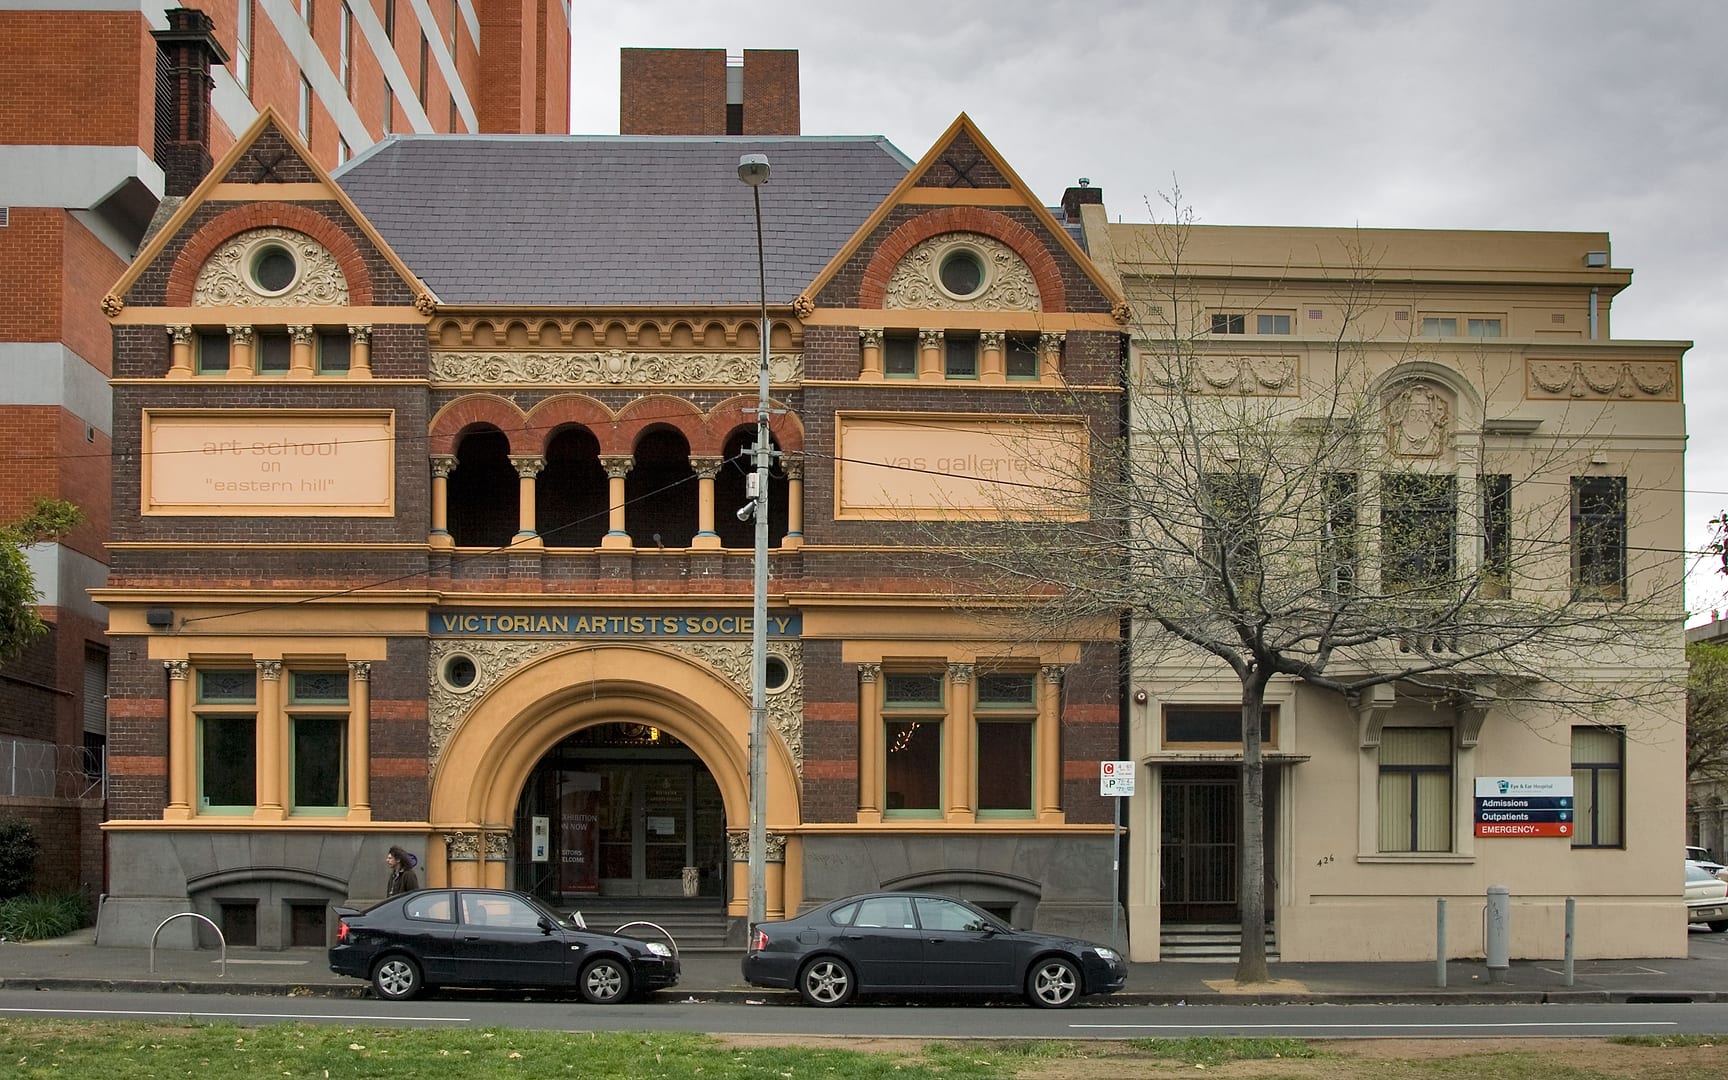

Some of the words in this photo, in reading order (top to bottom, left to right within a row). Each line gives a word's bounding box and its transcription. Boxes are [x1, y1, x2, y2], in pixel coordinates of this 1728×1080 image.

[203, 439, 243, 456] art
[251, 437, 338, 456] school
[261, 461, 281, 473] on
[884, 457, 927, 470] vas
[205, 478, 293, 492] "eastern
[300, 478, 335, 492] hill"
[442, 615, 569, 632] VICTORIAN
[575, 616, 683, 633] ARTISTS'
[686, 616, 791, 634] SOCIEY
[1482, 813, 1529, 821] Outpatients
[1316, 854, 1335, 867] 426
